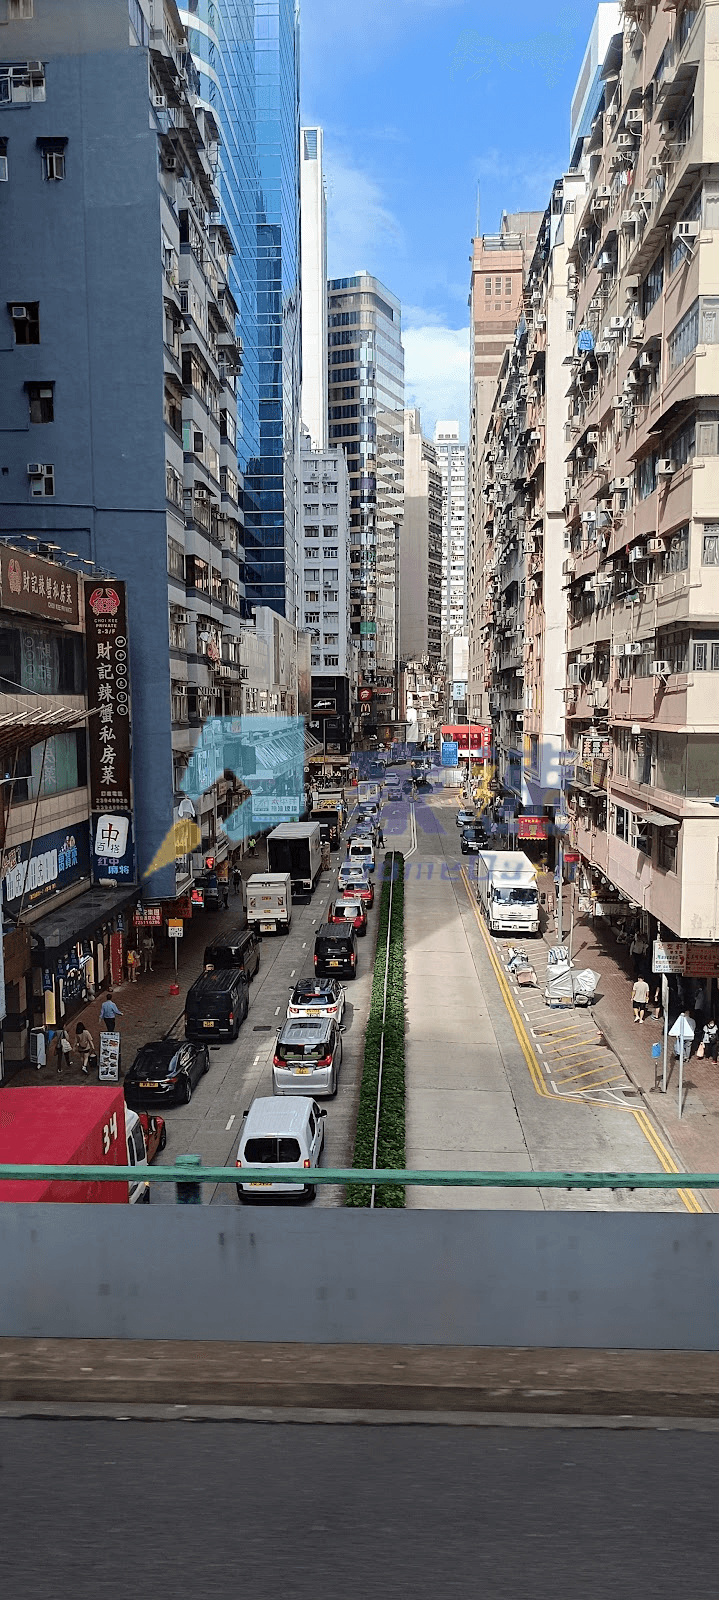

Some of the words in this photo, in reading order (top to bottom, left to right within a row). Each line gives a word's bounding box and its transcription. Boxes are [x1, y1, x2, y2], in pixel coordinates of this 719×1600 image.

[96, 641, 117, 785] 財記辣蟹私房菜
[102, 823, 119, 847] 中
